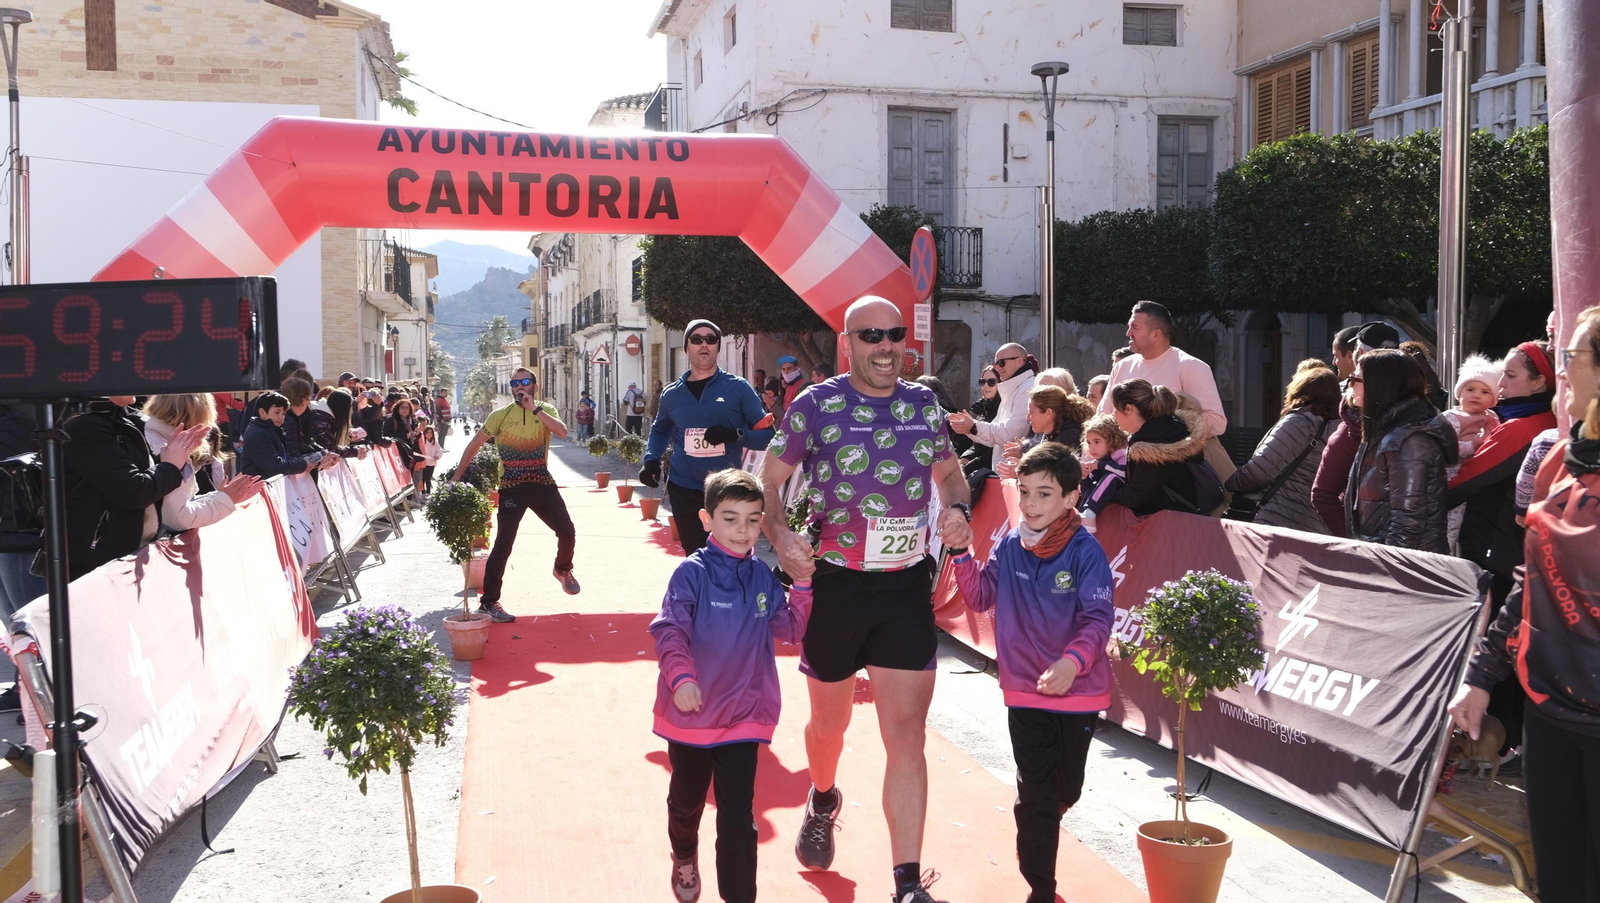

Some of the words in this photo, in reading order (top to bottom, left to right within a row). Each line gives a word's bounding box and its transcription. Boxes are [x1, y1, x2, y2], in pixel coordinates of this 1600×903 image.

[377, 128, 690, 163] AYUNTAMIENTO
[387, 167, 680, 220] CANTORIA
[880, 532, 918, 554] 226
[1218, 699, 1307, 746] www.teamergy.es
